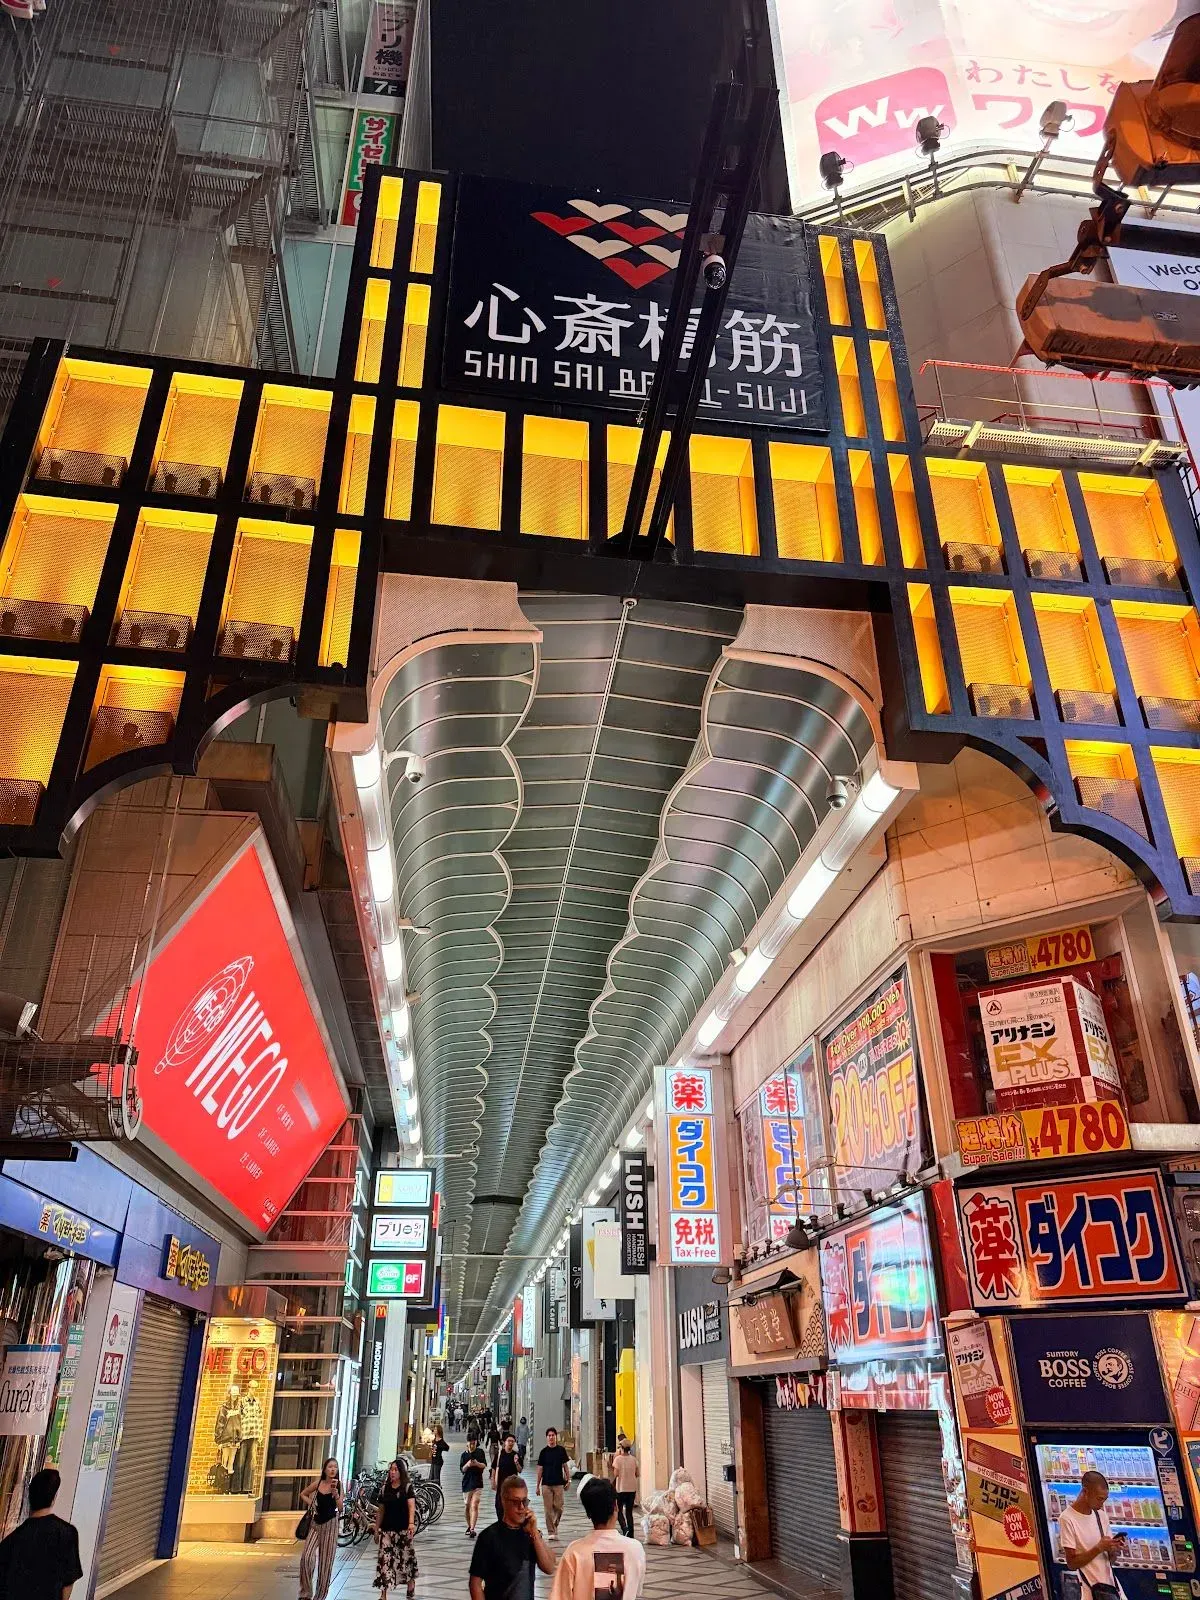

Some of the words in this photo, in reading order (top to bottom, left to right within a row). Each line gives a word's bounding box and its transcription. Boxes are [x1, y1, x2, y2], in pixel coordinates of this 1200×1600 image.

[373, 80, 398, 95] 7F
[464, 350, 538, 384] SHIN
[554, 361, 604, 392] SAI
[1031, 929, 1092, 969] ¥4780
[990, 1022, 1056, 1045] アリナミン
[184, 991, 289, 1140] WEGO
[993, 1037, 1058, 1073] EX
[1009, 1057, 1071, 1086] PLUS
[673, 1075, 705, 1112] 薬
[1029, 1102, 1125, 1157] ¥4780
[677, 1119, 706, 1206] ダイコク
[964, 1153, 989, 1166] Super
[992, 1151, 1013, 1162] Sale
[625, 1159, 644, 1230] LUSH
[675, 1217, 716, 1246] 免税
[636, 1233, 645, 1267] FRESH
[676, 1246, 717, 1259] Tax-Free
[966, 1194, 1022, 1296] 薬
[1028, 1189, 1167, 1288] ダイコク
[405, 1273, 419, 1284] 6F
[679, 1305, 706, 1349] LUSH
[955, 1350, 985, 1366] アリナミン
[1046, 1350, 1079, 1358] SUNTORY
[372, 1341, 383, 1391] McDonald's
[958, 1360, 986, 1383] EX
[1038, 1359, 1092, 1378] BOSS
[966, 1374, 995, 1393] PLUS
[1048, 1379, 1087, 1388] COFFEE
[1176, 1383, 1199, 1400] DHC
[988, 1391, 1004, 1403] NOW
[992, 1401, 1005, 1410] ON
[992, 1407, 1011, 1419] SALE!
[979, 1478, 1020, 1504] パブロン
[1005, 1512, 1022, 1524] NOW
[1009, 1521, 1023, 1531] ON
[1010, 1530, 1029, 1541] SALE!
[1021, 1581, 1035, 1596] EVE
